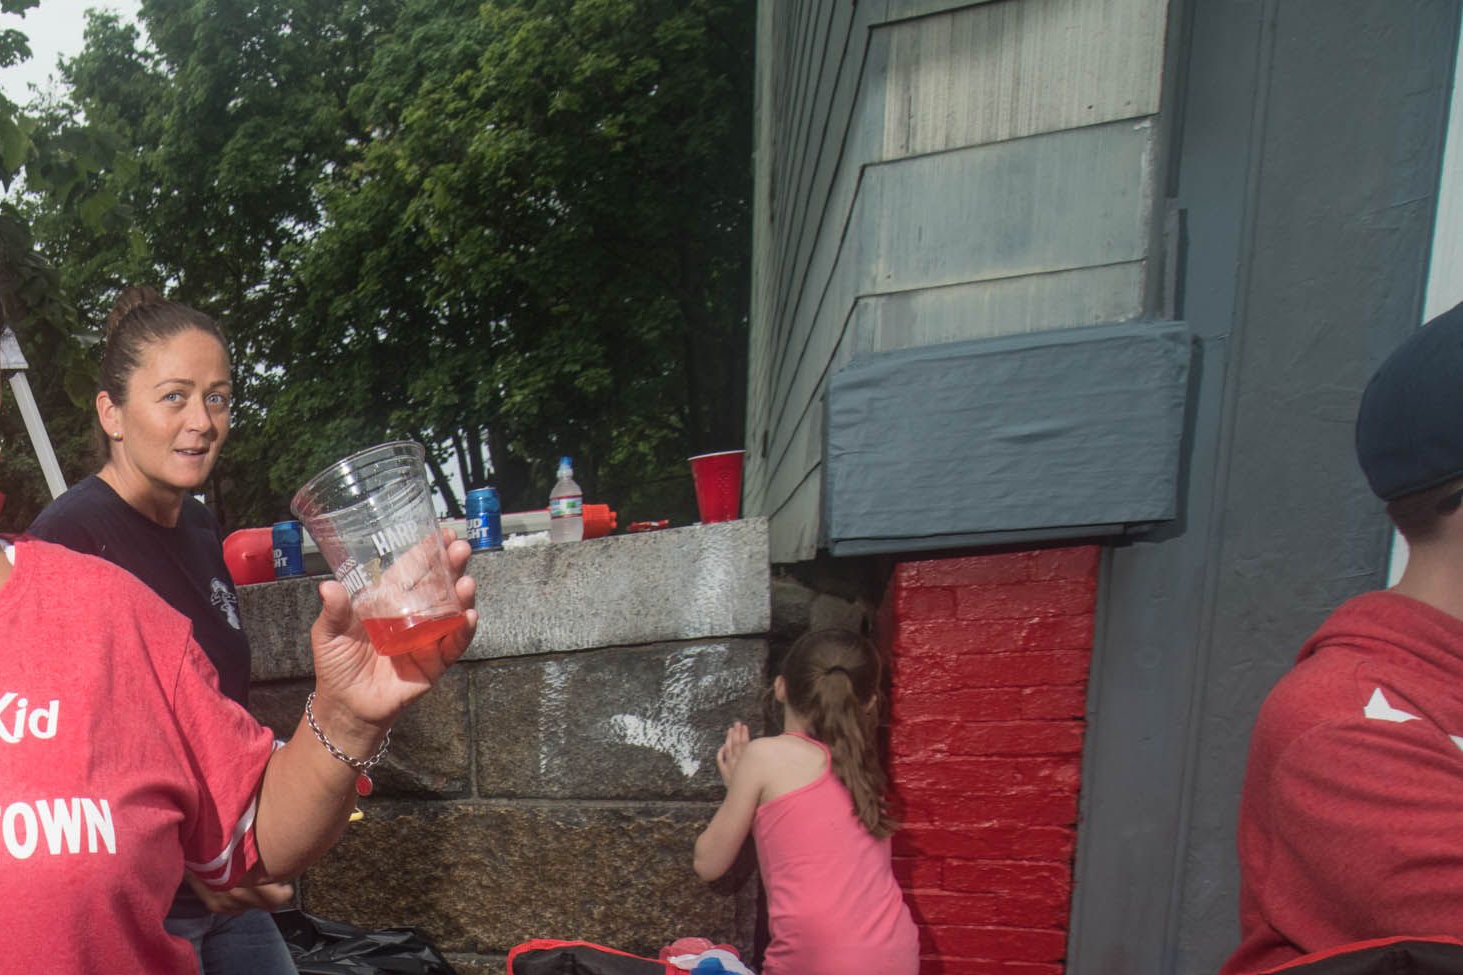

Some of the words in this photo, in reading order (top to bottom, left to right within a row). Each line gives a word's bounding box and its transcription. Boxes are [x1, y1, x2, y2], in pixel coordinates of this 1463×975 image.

[466, 518, 482, 529] UD
[371, 519, 418, 556] HARP
[466, 526, 489, 539] GHT
